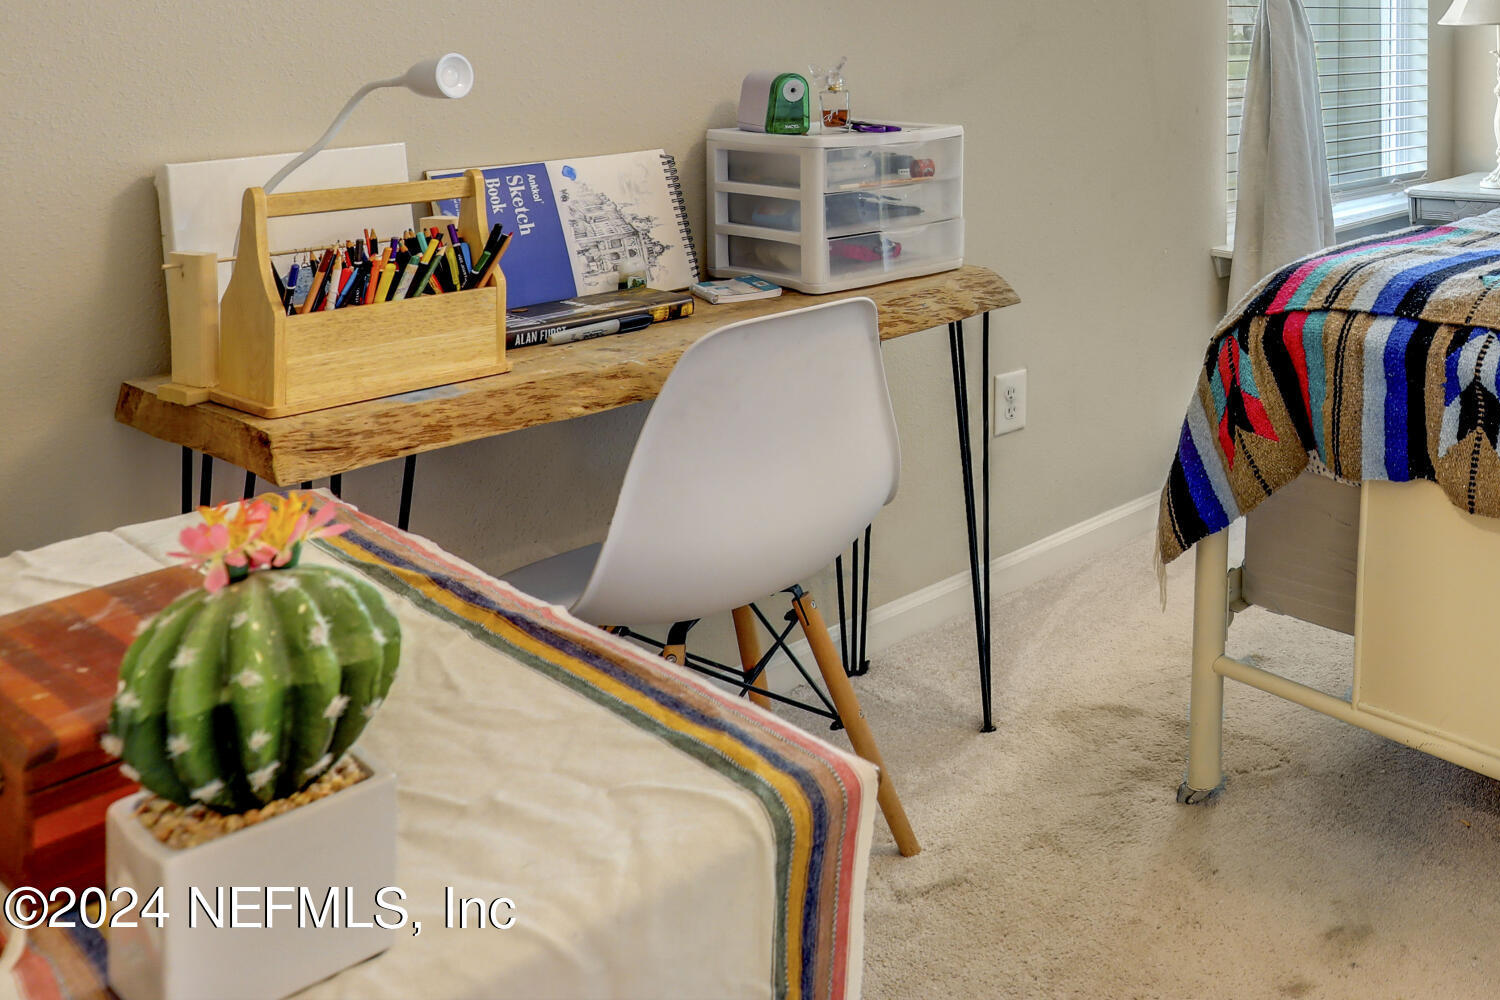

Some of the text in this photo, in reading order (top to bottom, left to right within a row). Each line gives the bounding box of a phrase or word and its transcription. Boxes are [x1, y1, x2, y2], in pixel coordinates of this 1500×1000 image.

[485, 177, 507, 215] Book
[505, 173, 536, 237] Sketch
[526, 173, 543, 203] Ankkol
[514, 331, 538, 346] ALAN
